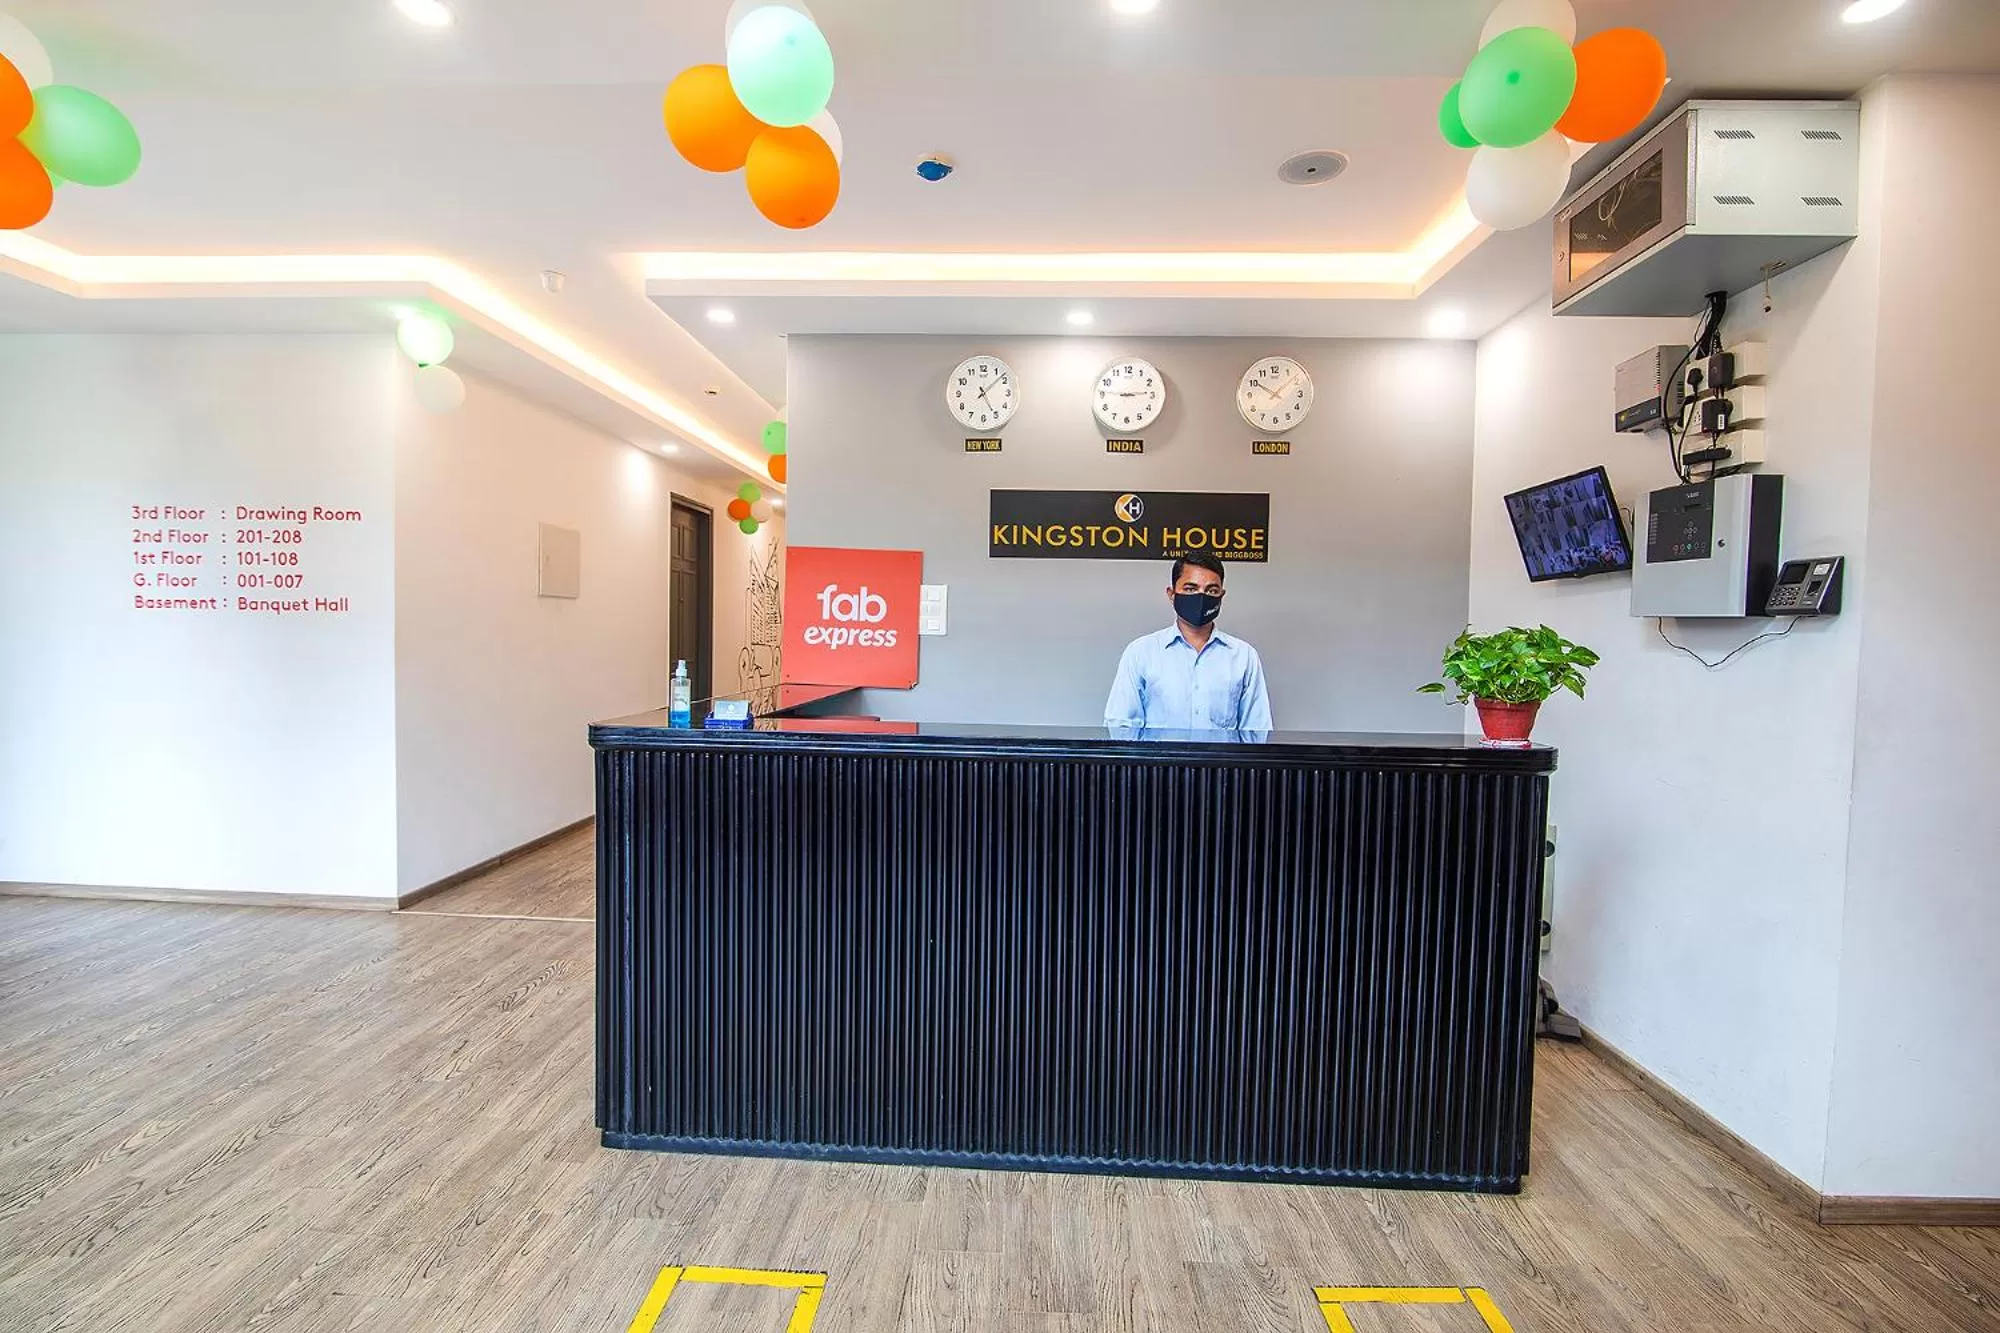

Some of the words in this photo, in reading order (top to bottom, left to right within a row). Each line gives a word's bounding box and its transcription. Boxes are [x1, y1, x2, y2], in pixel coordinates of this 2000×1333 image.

[1124, 366, 1132, 374] 12
[1271, 366, 1279, 374] 12
[1002, 376, 1007, 384] 2
[1102, 378, 1111, 387] 10
[1147, 378, 1152, 387] 2
[1006, 389, 1011, 397] 3
[993, 411, 999, 419] 5
[982, 440, 1001, 450] YORK
[1108, 441, 1142, 452] INDIA
[1254, 443, 1289, 453] LONDON
[132, 506, 158, 520] 3rd
[164, 506, 204, 520] Floor
[236, 507, 307, 524] Drawing
[313, 507, 361, 521] Room
[132, 529, 162, 543] 2nd
[168, 530, 208, 544] Floor
[236, 530, 302, 544] 201-208
[993, 525, 1148, 548] KINGSTON
[1162, 527, 1265, 549] HOUSE
[133, 552, 156, 564] 1st
[161, 552, 202, 565] Floor
[237, 552, 298, 566] 101-108
[133, 573, 151, 587] G.
[156, 573, 197, 587] Floor
[237, 574, 303, 588] 001-007
[134, 596, 216, 609] Basement
[238, 598, 309, 614] Banquet
[315, 598, 349, 611] Hall
[816, 584, 888, 623] fab
[803, 625, 897, 650] express
